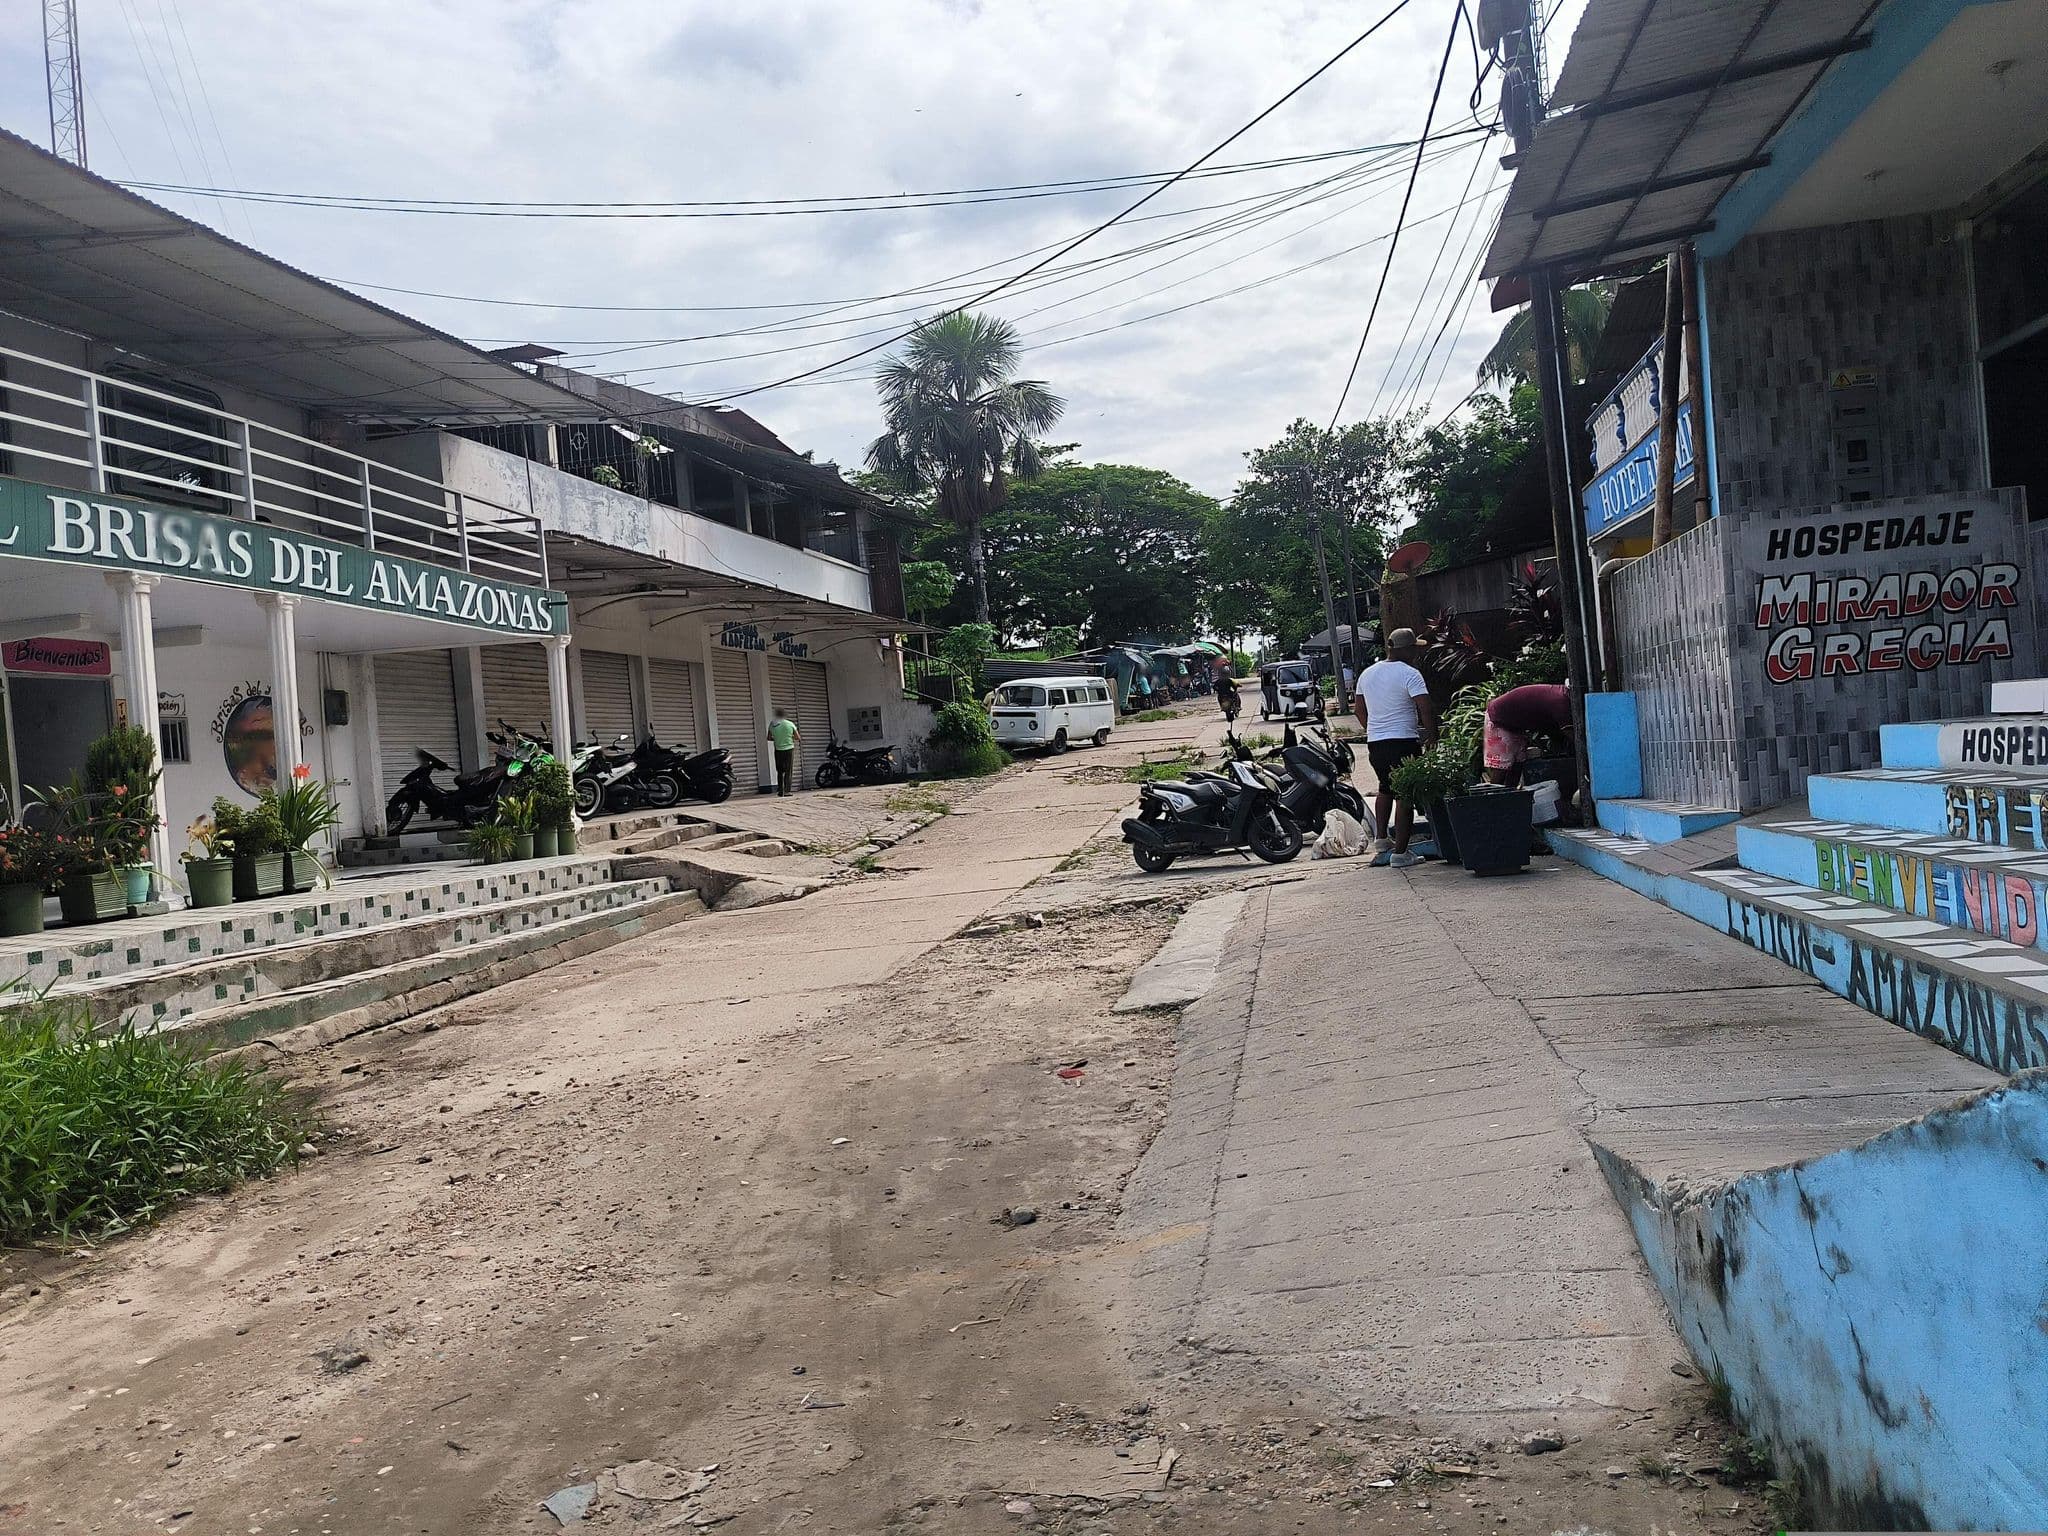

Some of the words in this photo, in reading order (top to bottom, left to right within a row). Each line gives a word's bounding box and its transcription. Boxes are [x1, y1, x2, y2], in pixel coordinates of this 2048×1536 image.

[1599, 457, 1647, 521] HOTEL
[46, 494, 253, 578] BRISAS
[269, 537, 353, 596] DEL
[363, 560, 553, 631] AMAZONAS
[1766, 510, 1974, 561] HOSPEDAJE
[1755, 562, 2021, 630] MIRADOR
[14, 639, 105, 668] Bienvenidos!
[1765, 618, 2014, 686] GRECIA
[1815, 840, 2048, 947] BIENVENID
